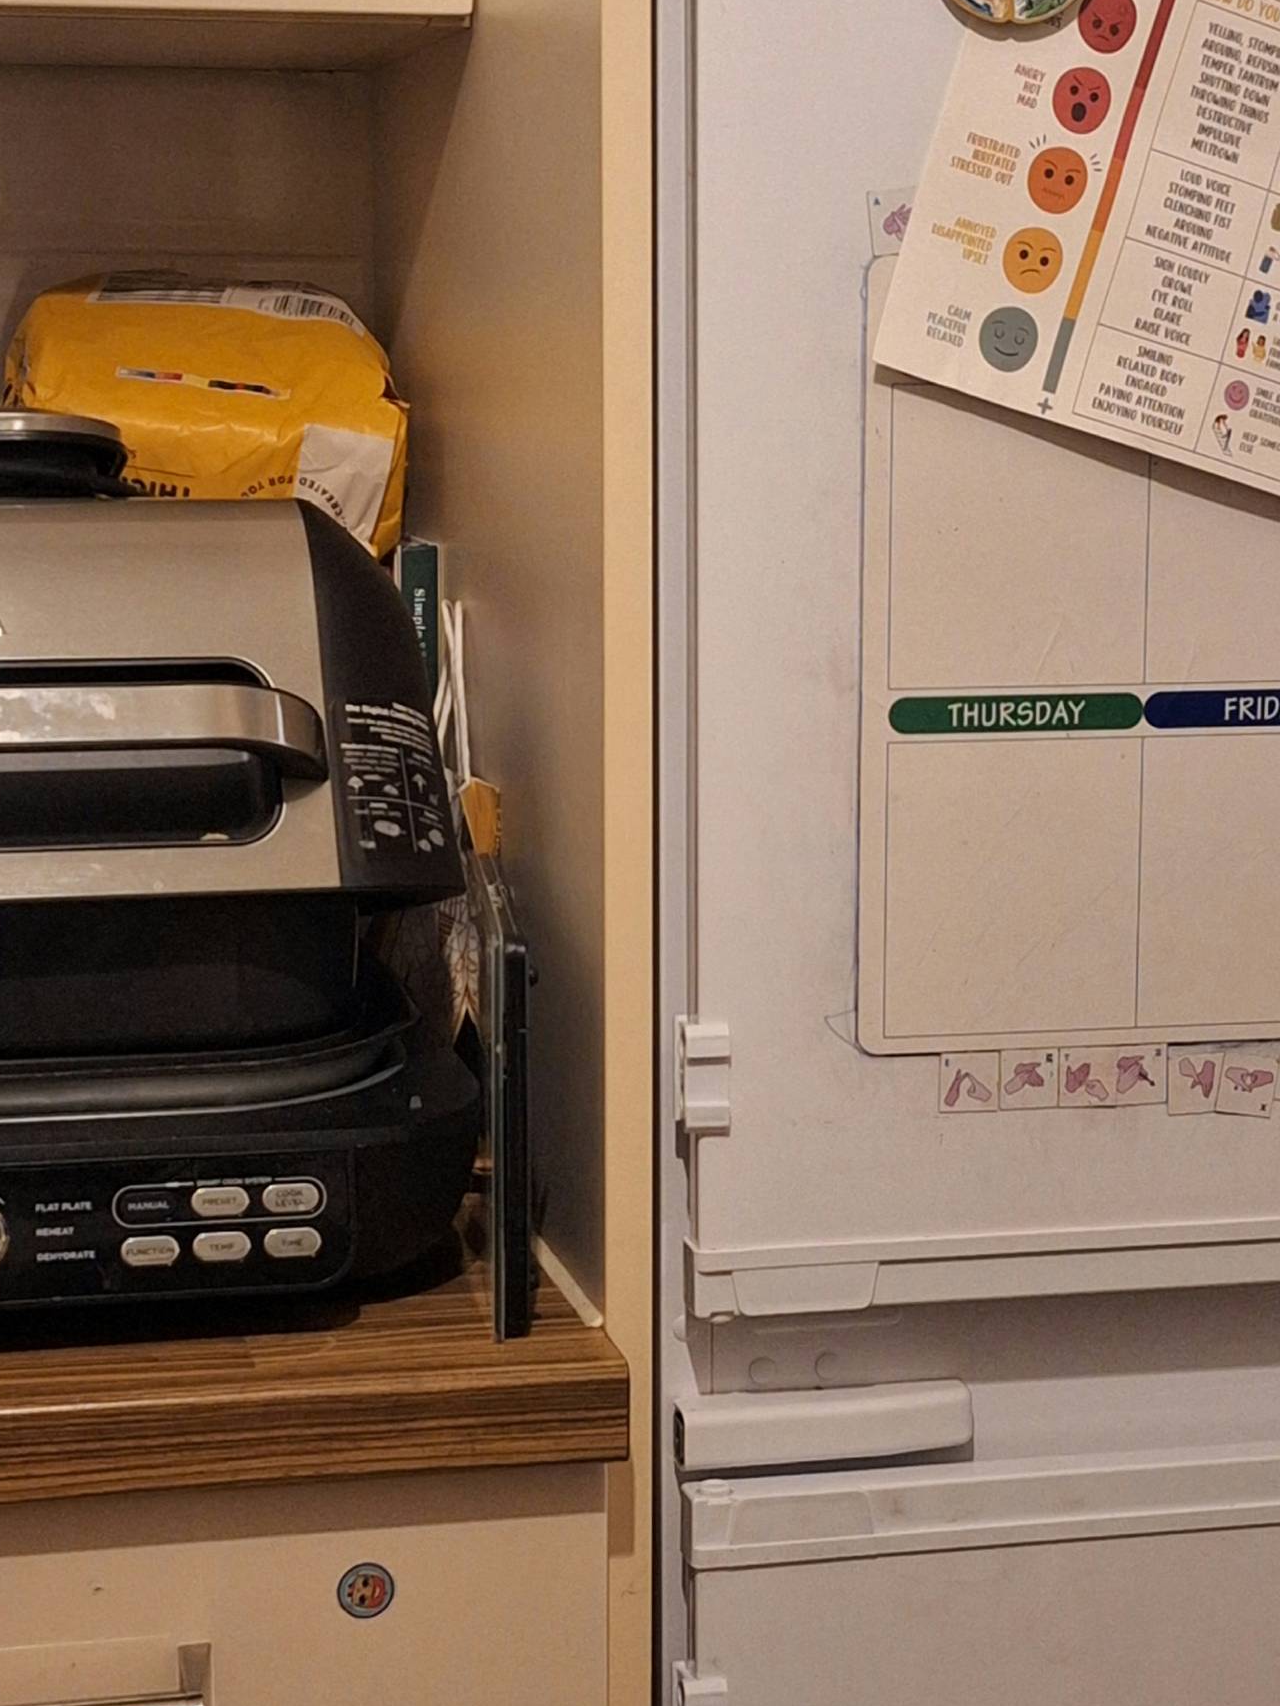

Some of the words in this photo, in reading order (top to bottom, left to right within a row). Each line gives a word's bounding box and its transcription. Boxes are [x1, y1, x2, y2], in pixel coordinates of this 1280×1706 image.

[1133, 316, 1161, 336] RAISE
[1163, 326, 1191, 346] VOICE
[1135, 393, 1185, 420] ATTENTION
[1139, 411, 1183, 436] YOURSELF
[947, 700, 1086, 728] THURSDAY
